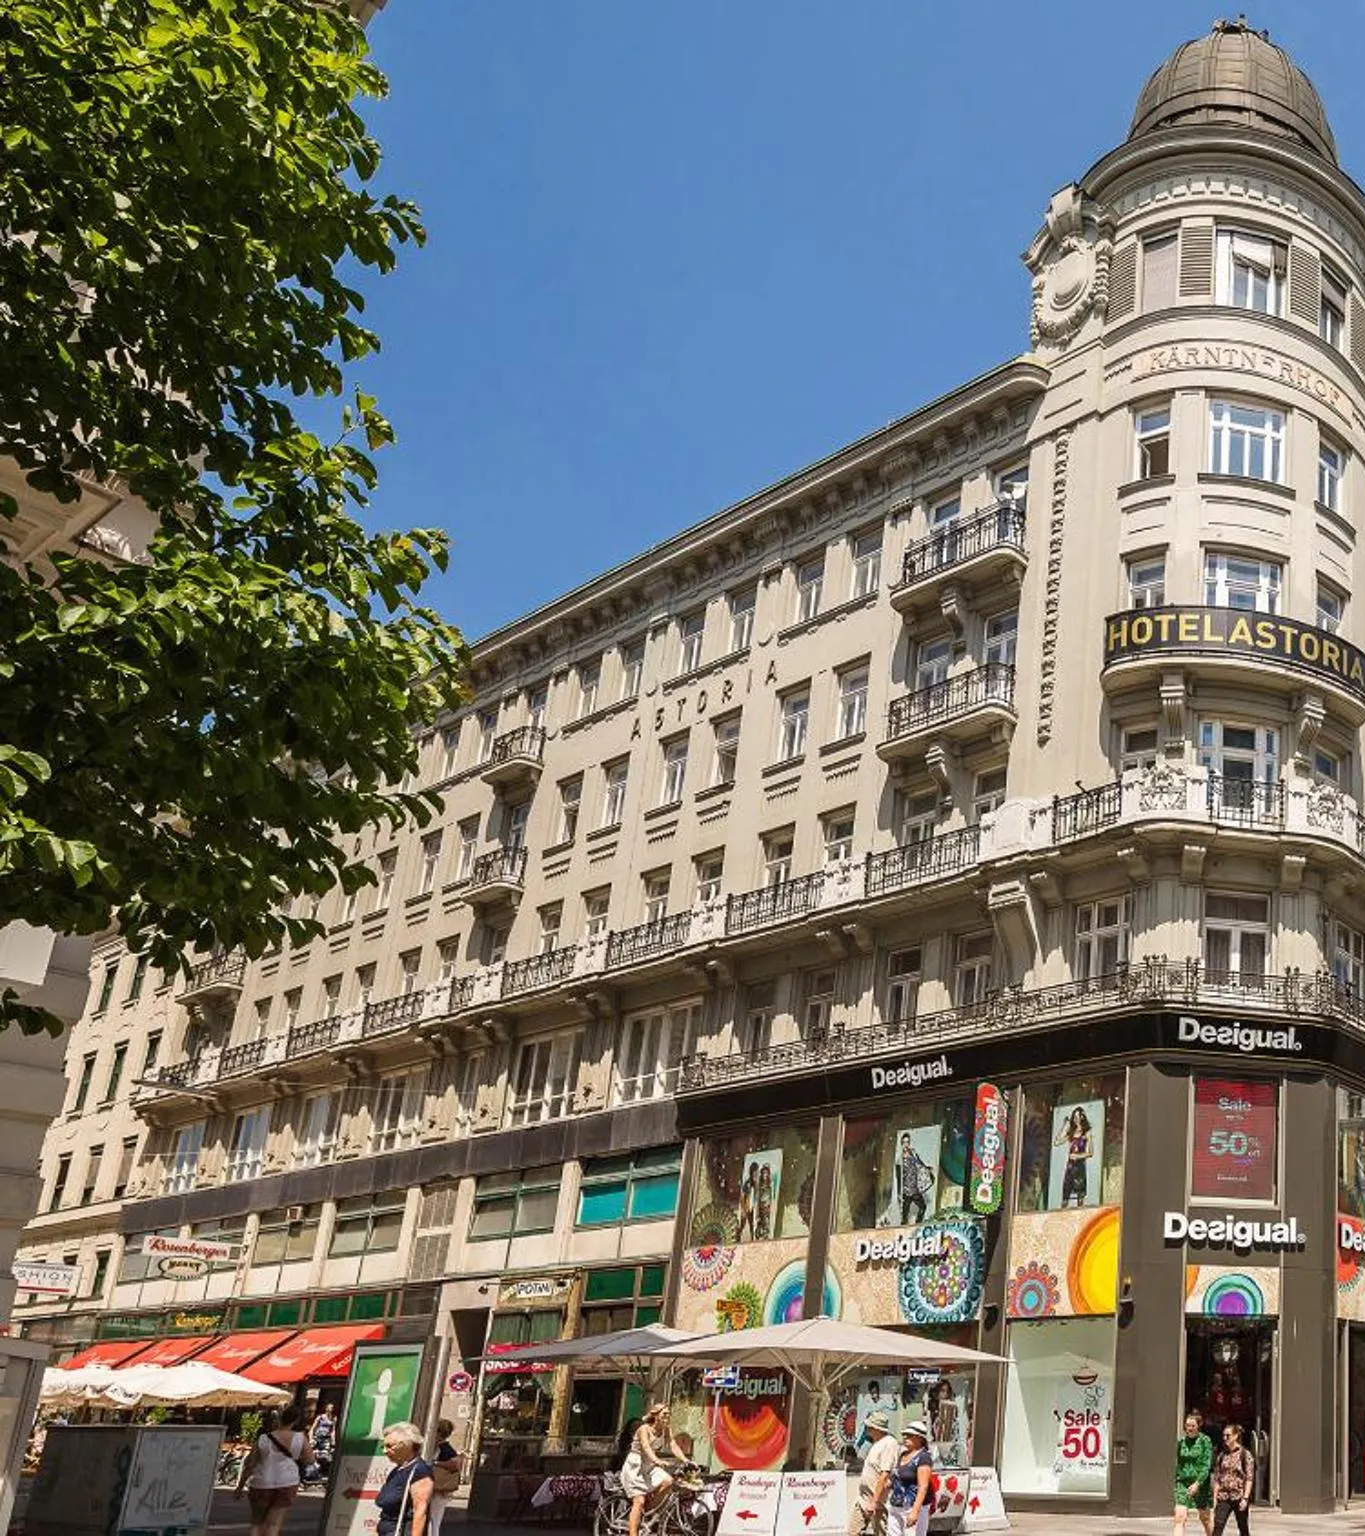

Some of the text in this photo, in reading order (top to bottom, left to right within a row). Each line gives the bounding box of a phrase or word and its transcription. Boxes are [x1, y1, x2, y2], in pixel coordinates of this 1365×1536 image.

[1108, 613, 1365, 687] HOTEL ASTORIA
[630, 660, 777, 741] ASTORIA
[1178, 1016, 1296, 1051] Desigual
[871, 1055, 947, 1089] Desigual
[976, 1097, 1000, 1204] Desigual
[855, 1230, 941, 1262] Desigual
[1164, 1212, 1297, 1247] Desigual
[150, 1237, 228, 1259] Rosenberger
[1064, 1408, 1100, 1426] Sale
[1063, 1427, 1100, 1458] 50
